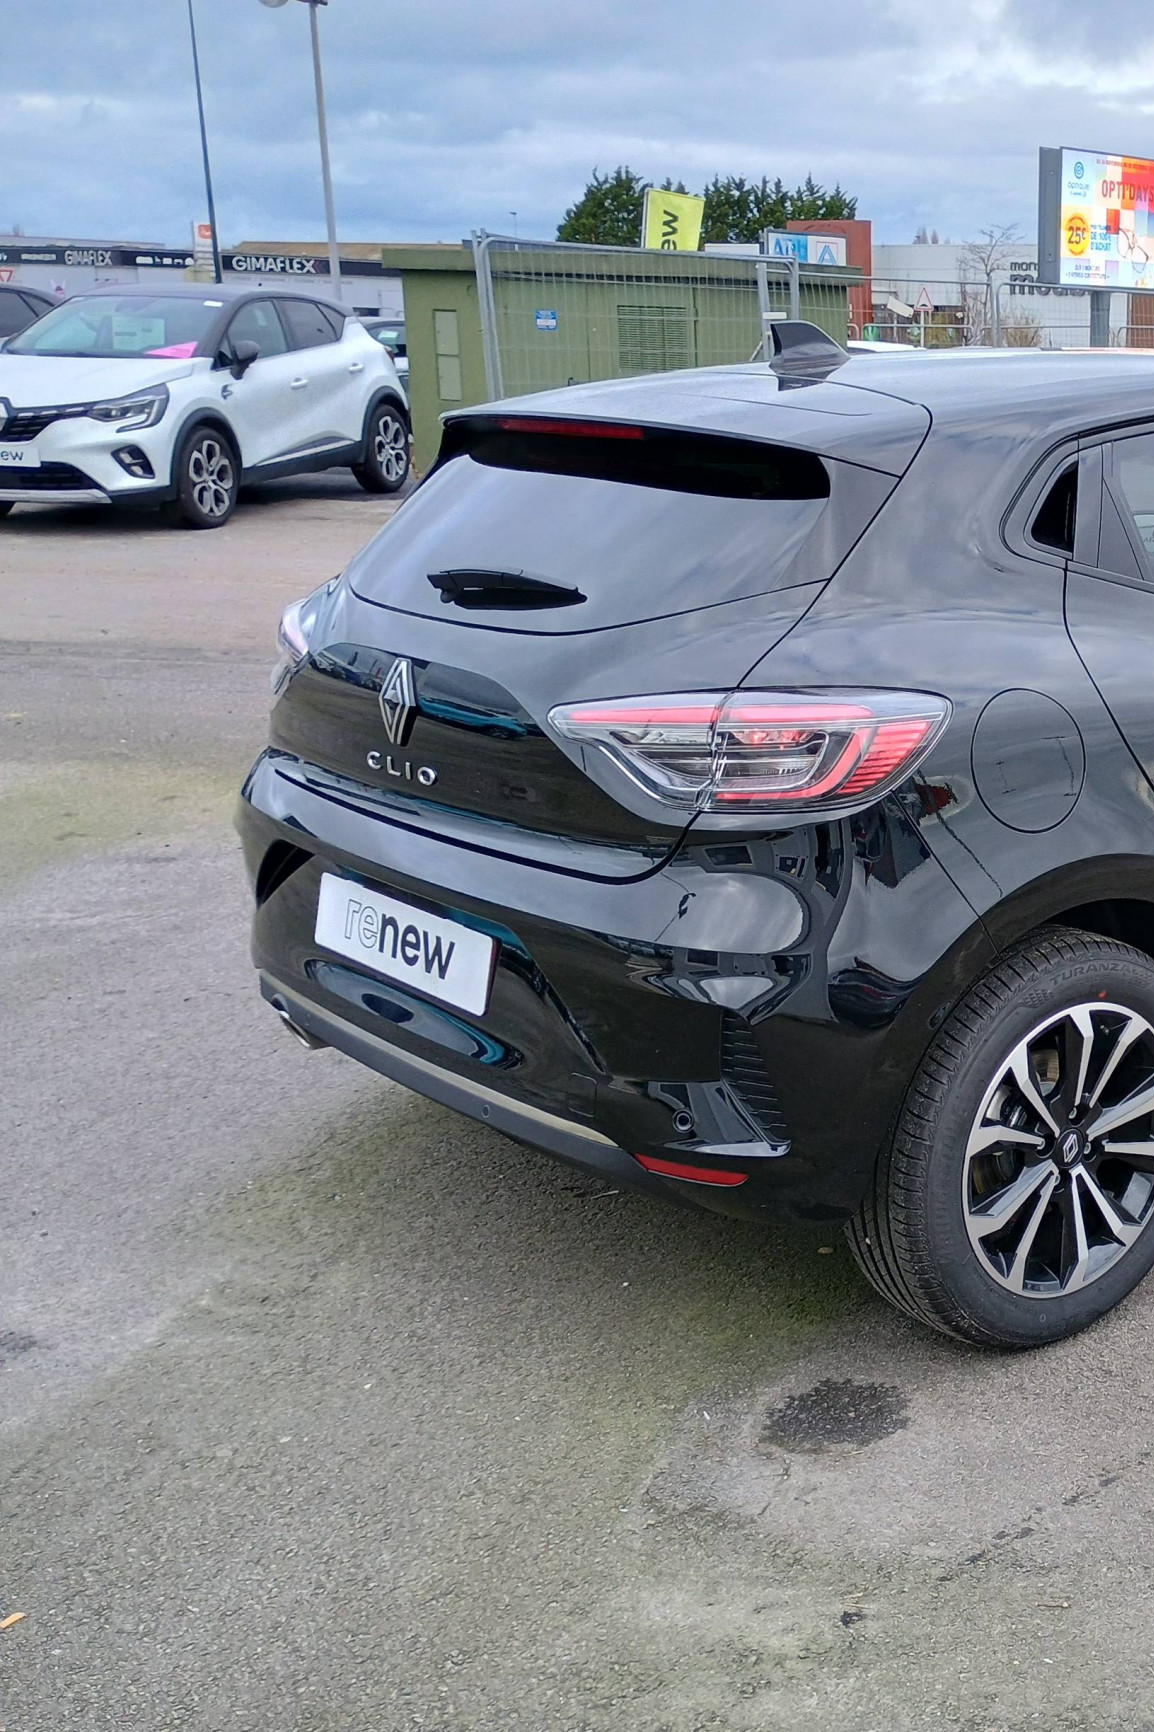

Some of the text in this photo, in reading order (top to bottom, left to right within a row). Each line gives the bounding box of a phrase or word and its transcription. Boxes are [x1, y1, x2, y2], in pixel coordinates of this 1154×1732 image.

[1101, 179, 1154, 202] OPTI'DAYS
[1067, 225, 1087, 245] 25€
[64, 250, 113, 266] GIMAFLEX
[231, 256, 317, 274] GIMAFLEX
[366, 750, 438, 787] CLIO
[344, 898, 455, 980] renew
[1049, 962, 1134, 985] TURANZA
